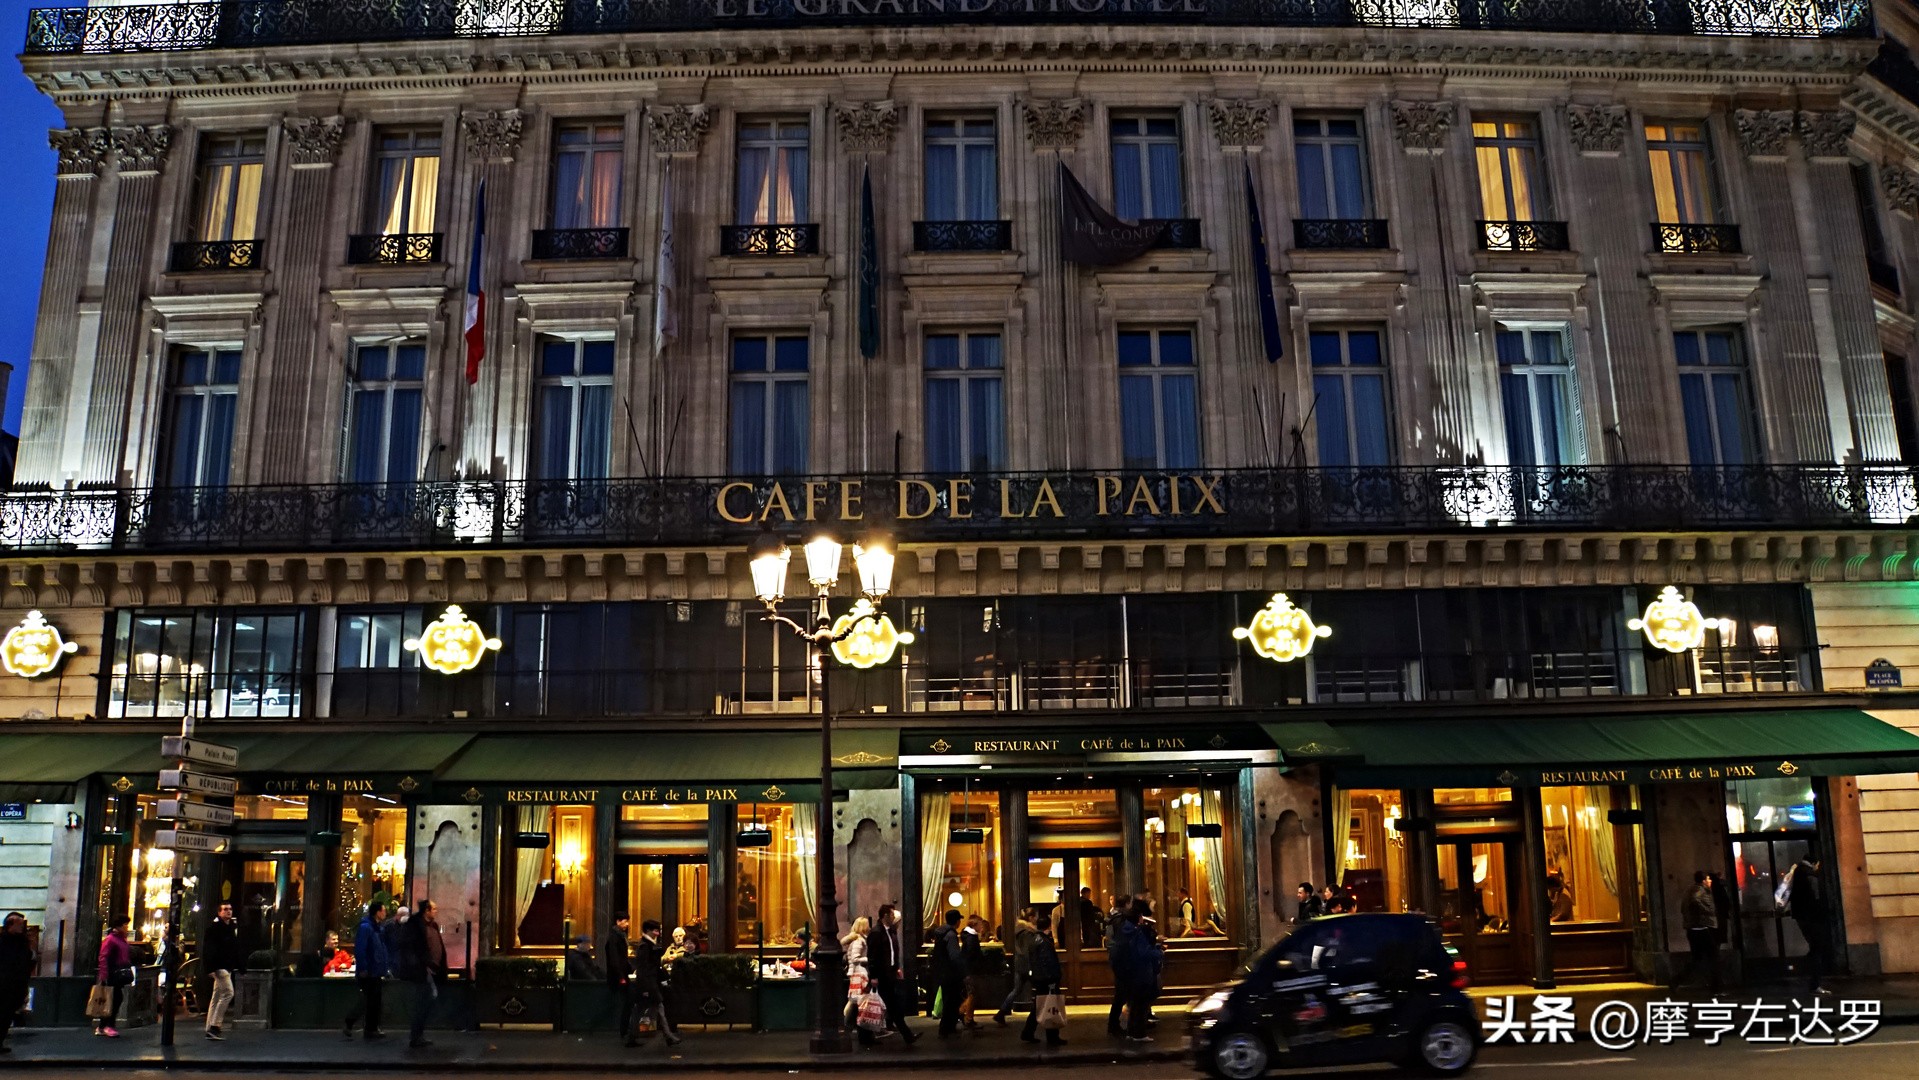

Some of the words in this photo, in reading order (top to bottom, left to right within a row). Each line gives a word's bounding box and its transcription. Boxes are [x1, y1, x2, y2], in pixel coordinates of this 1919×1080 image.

[716, 481, 864, 523] CAFE
[896, 479, 973, 520] DE
[997, 477, 1065, 518] LA
[1094, 475, 1227, 516] PAIX
[974, 740, 1060, 752] RESTAURANT
[1080, 737, 1114, 750] CAFÉ
[1120, 738, 1133, 749] de
[1140, 738, 1150, 749] la
[1157, 737, 1186, 749] PAIX
[1542, 770, 1627, 783] RESTAURANT
[1650, 766, 1683, 780] CAFÉ
[1689, 767, 1703, 779] de
[1709, 766, 1720, 778] la
[1726, 765, 1756, 777] PAIX
[199, 777, 234, 792] RÉPUBLIQUE
[265, 778, 299, 791] CAFÉ
[306, 779, 320, 791] de
[326, 779, 336, 791] la
[343, 780, 374, 791] PAIX
[507, 790, 599, 802] RESTAURANT
[622, 787, 658, 801] CAFÉ
[665, 788, 680, 801] de
[687, 788, 698, 800] la
[705, 789, 738, 801] PAIX
